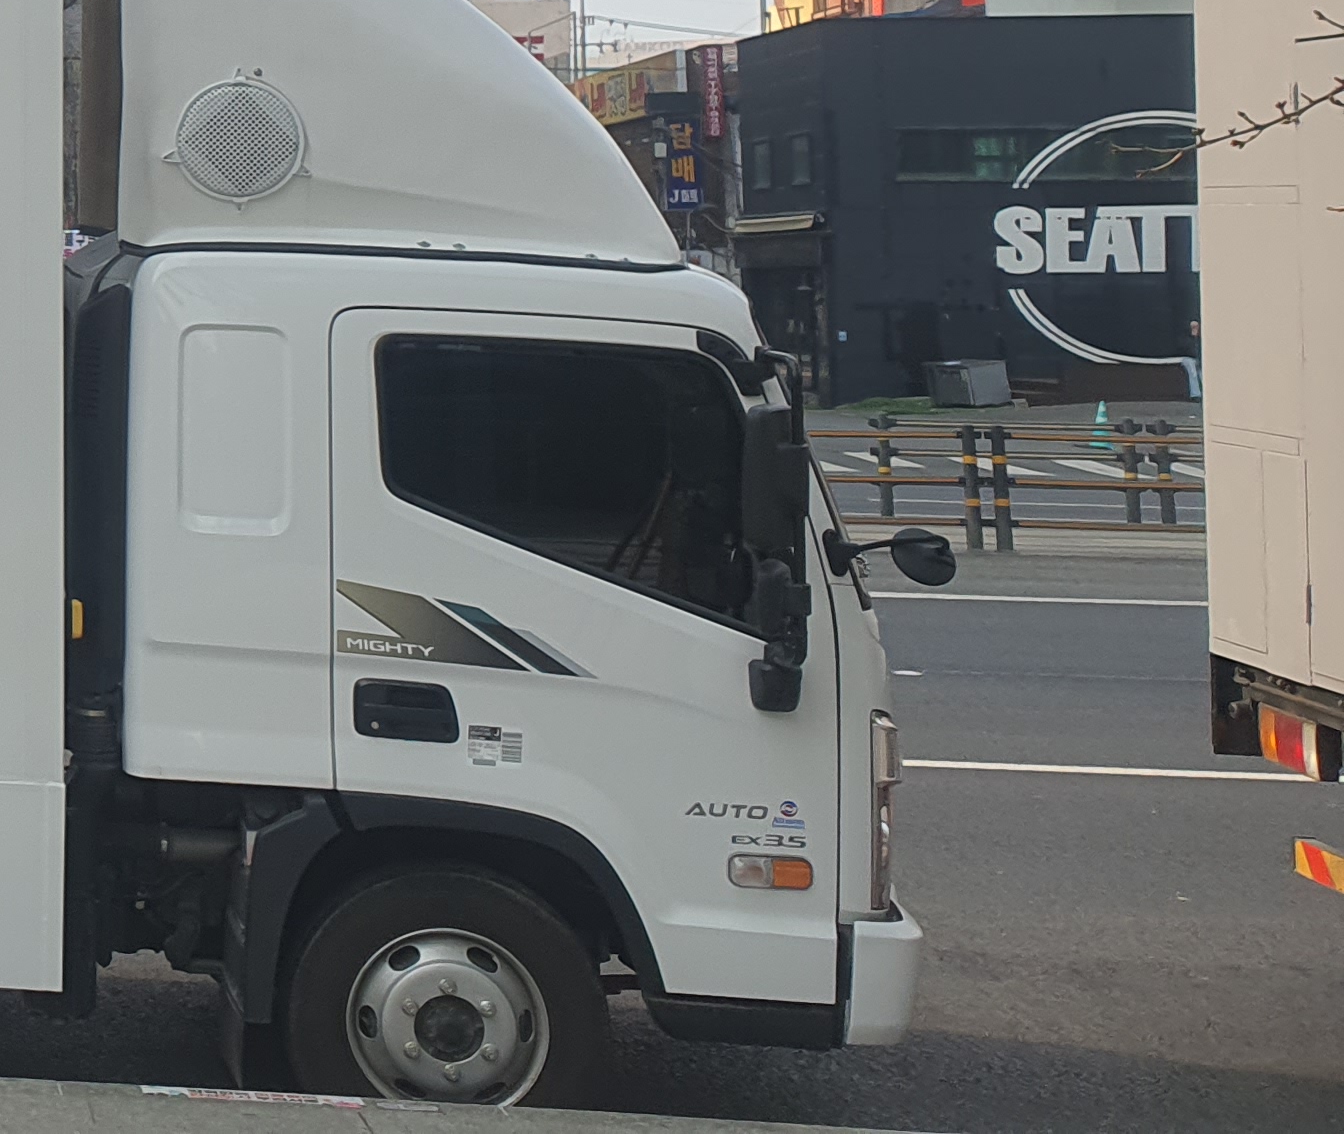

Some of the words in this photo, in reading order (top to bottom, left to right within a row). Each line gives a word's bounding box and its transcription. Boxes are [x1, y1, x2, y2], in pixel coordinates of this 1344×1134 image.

[669, 122, 696, 183] 담배
[346, 637, 435, 657] MIGHTY
[684, 802, 769, 820] AUTO
